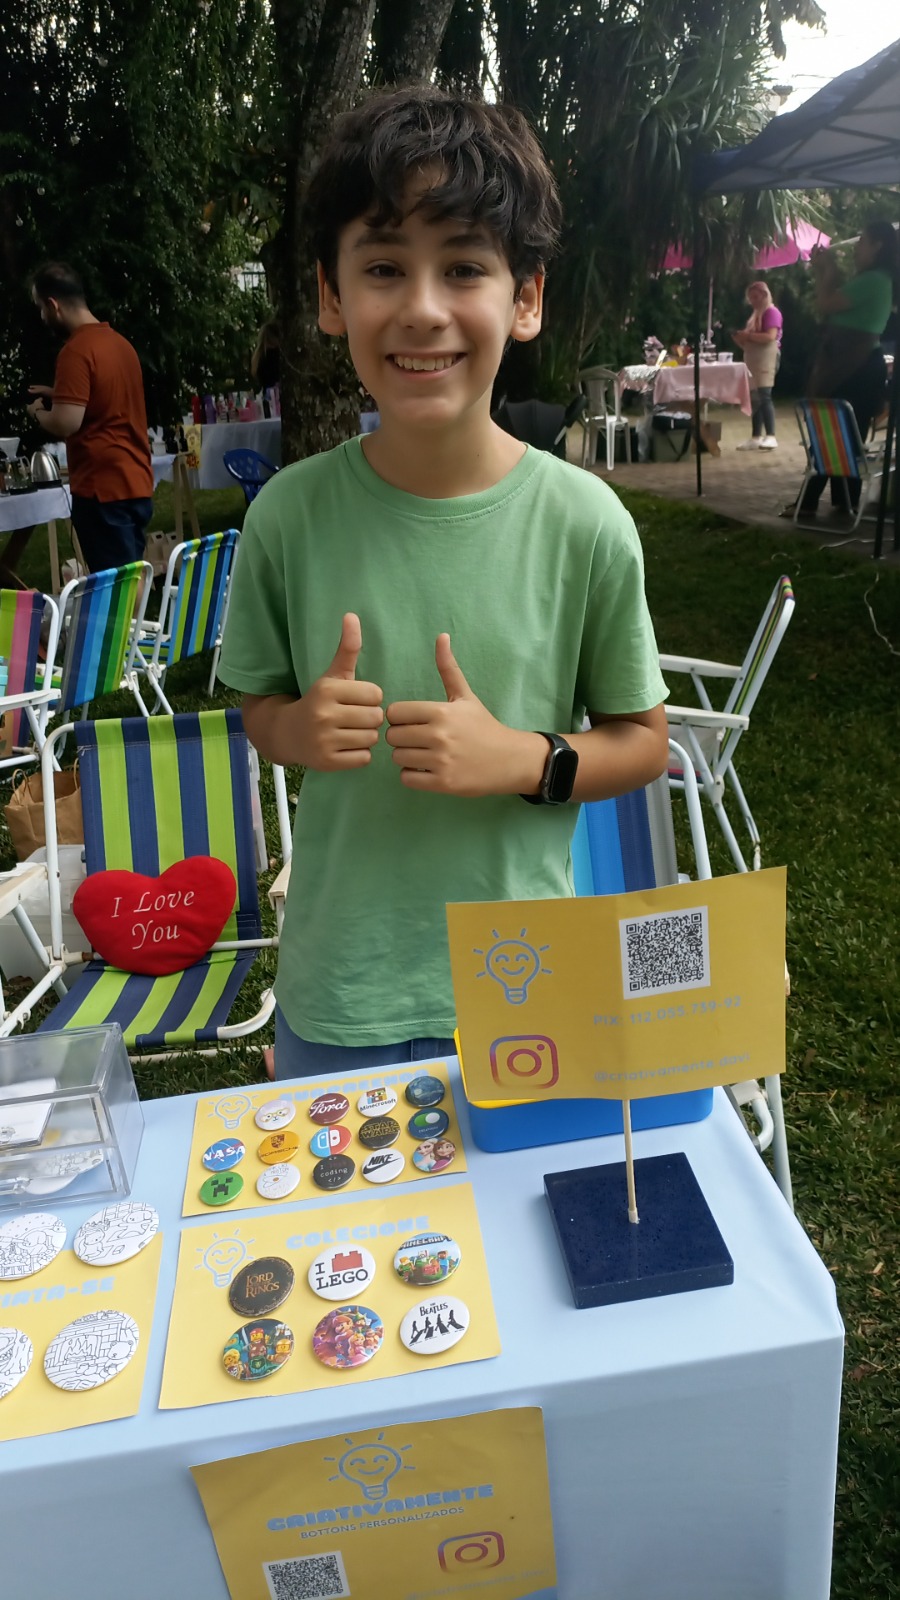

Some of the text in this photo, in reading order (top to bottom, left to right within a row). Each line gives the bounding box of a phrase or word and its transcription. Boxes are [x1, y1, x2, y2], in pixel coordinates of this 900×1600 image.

[111, 890, 195, 918] I Love
[131, 920, 180, 950] You
[309, 1098, 348, 1117] Ford
[360, 1098, 396, 1112] Minecrosoft
[361, 1120, 400, 1132] STAR
[361, 1126, 400, 1139] WARS
[202, 1145, 246, 1162] NASA
[368, 1153, 393, 1165] NIKE
[320, 1167, 348, 1178] coding
[286, 1215, 430, 1249] COLECIONE
[314, 1262, 326, 1276] I
[246, 1271, 274, 1288] LORD
[316, 1268, 369, 1291] LEGO
[245, 1281, 280, 1298] RINGS
[419, 1302, 449, 1316] BEATLES
[266, 1484, 494, 1531] CRIATIVAMENTE
[300, 1506, 464, 1540] BOTTONS PERSONALIZADOS
